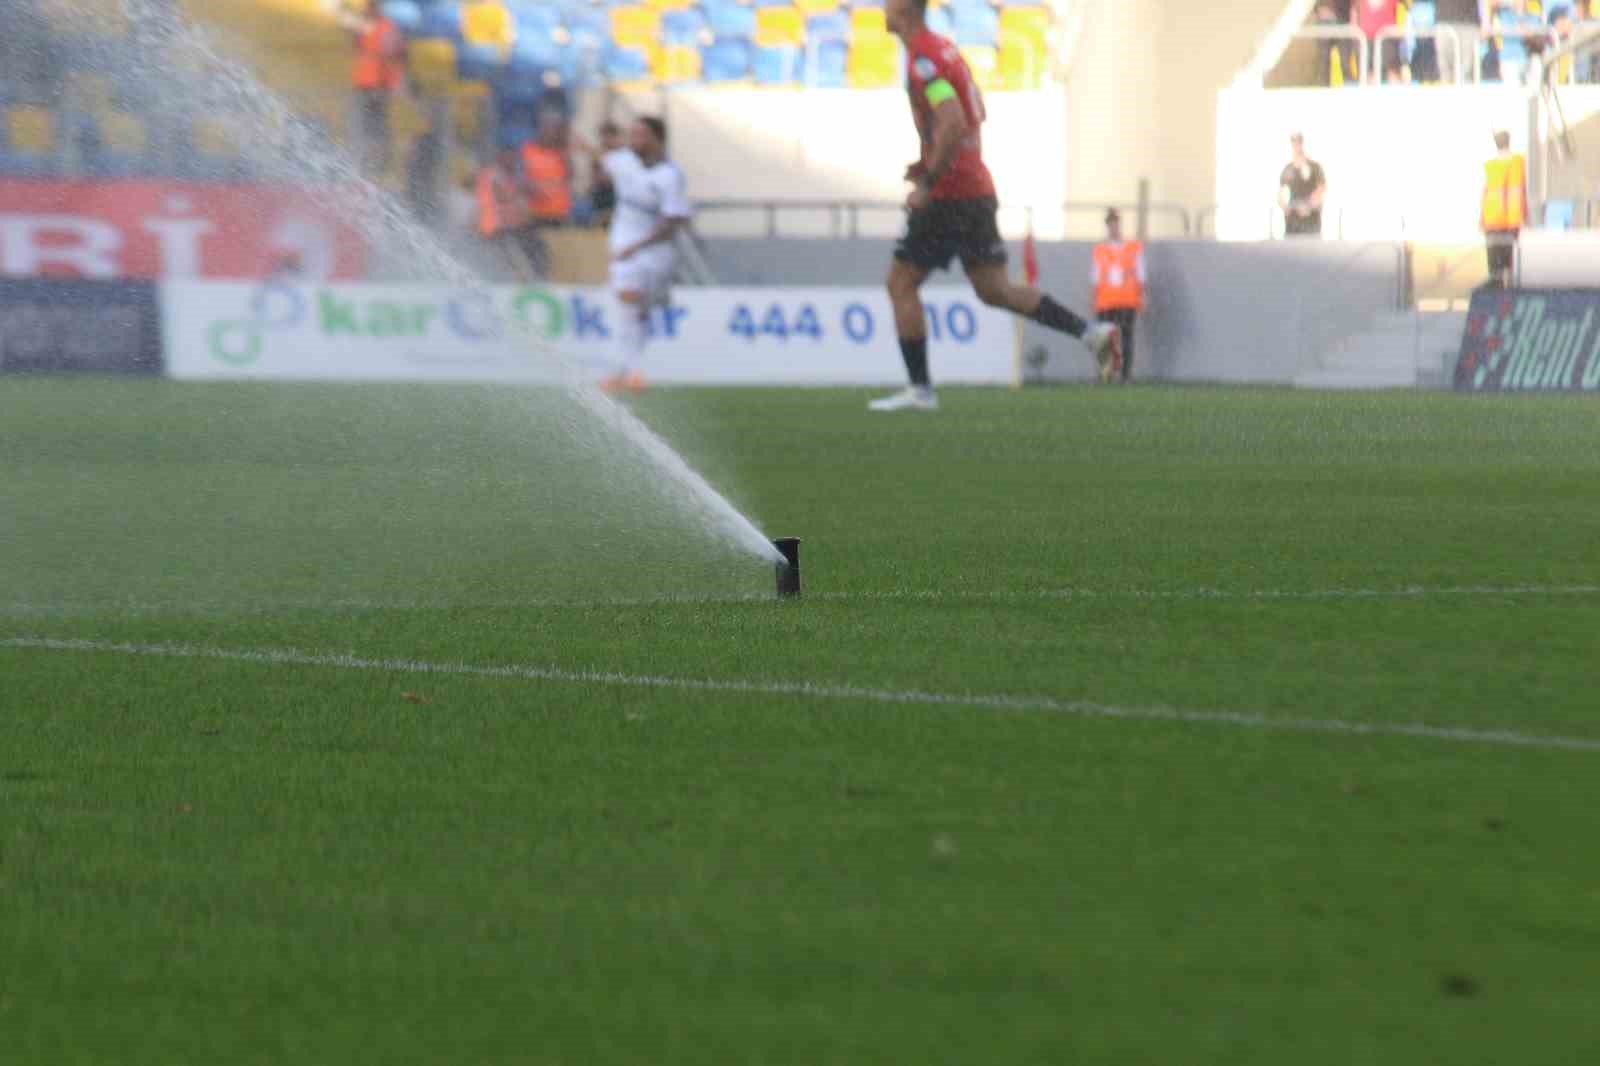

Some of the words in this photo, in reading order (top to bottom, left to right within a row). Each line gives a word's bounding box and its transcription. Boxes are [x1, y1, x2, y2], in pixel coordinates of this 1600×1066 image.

[728, 302, 823, 341] 444
[843, 302, 875, 344] 0
[1502, 295, 1594, 388] Rent
